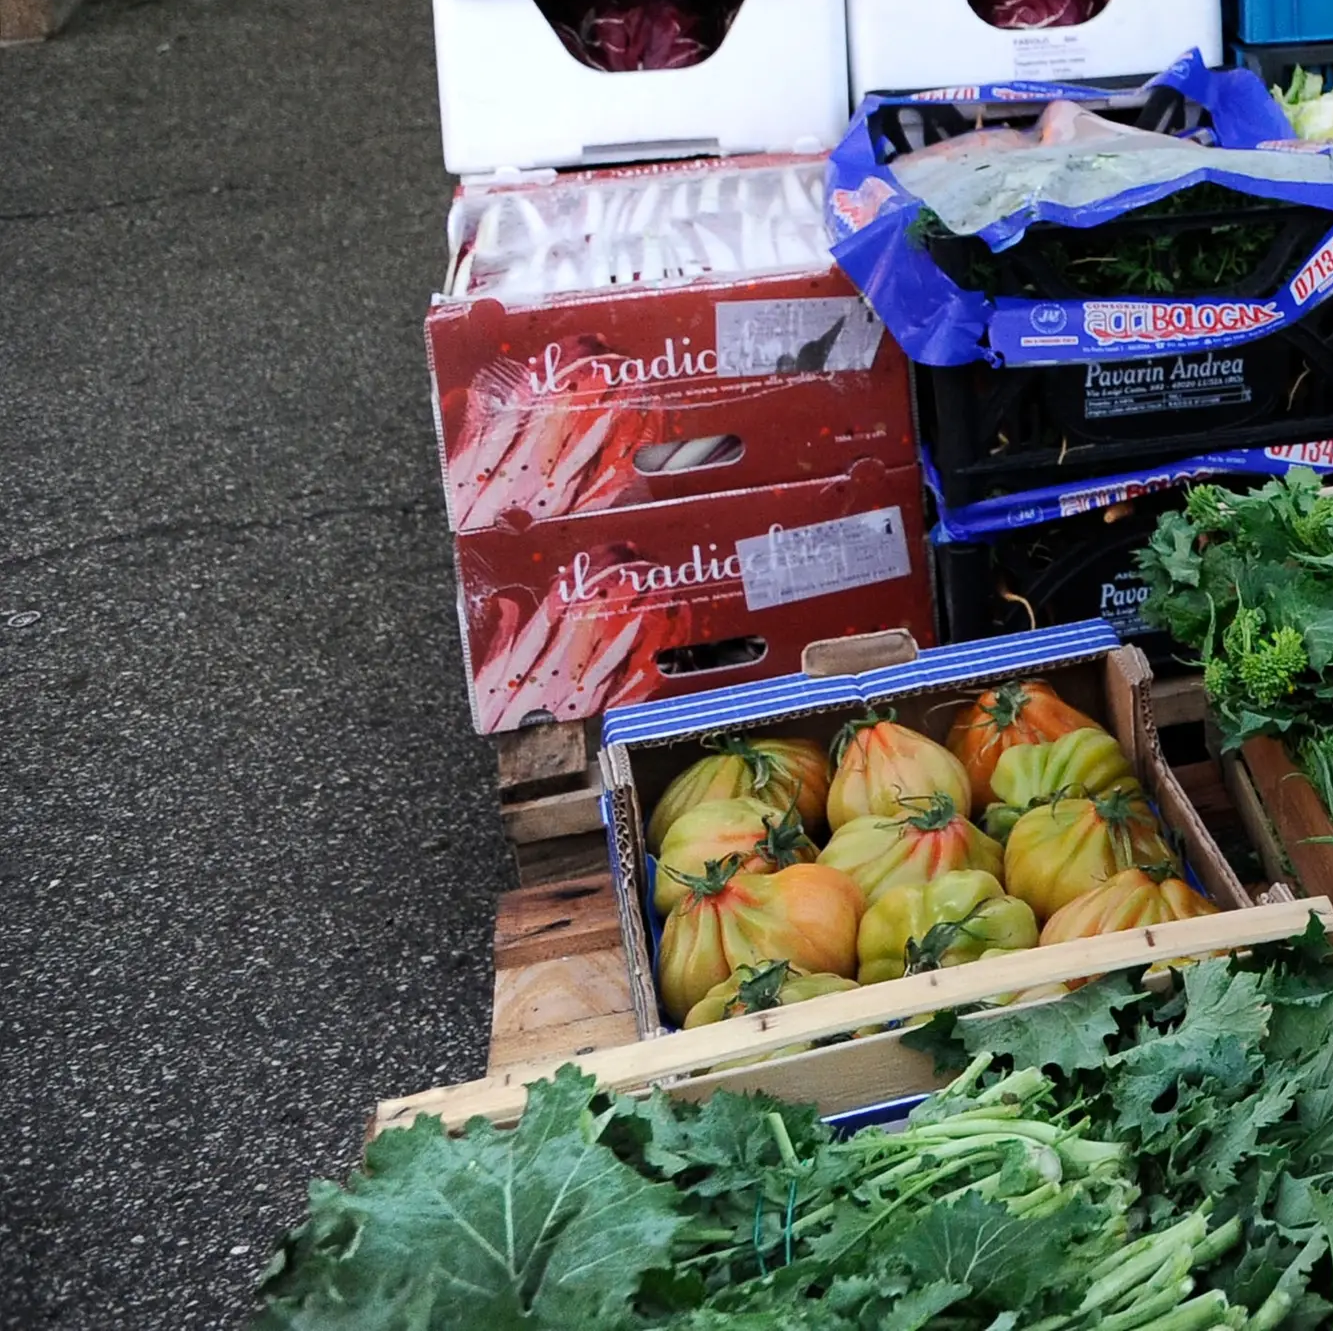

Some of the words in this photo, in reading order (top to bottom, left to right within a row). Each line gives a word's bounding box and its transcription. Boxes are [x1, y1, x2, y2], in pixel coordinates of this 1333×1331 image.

[527, 342, 570, 395] il
[1084, 360, 1165, 388] Pavarin
[1169, 352, 1245, 380] Andrea
[556, 552, 599, 603] il
